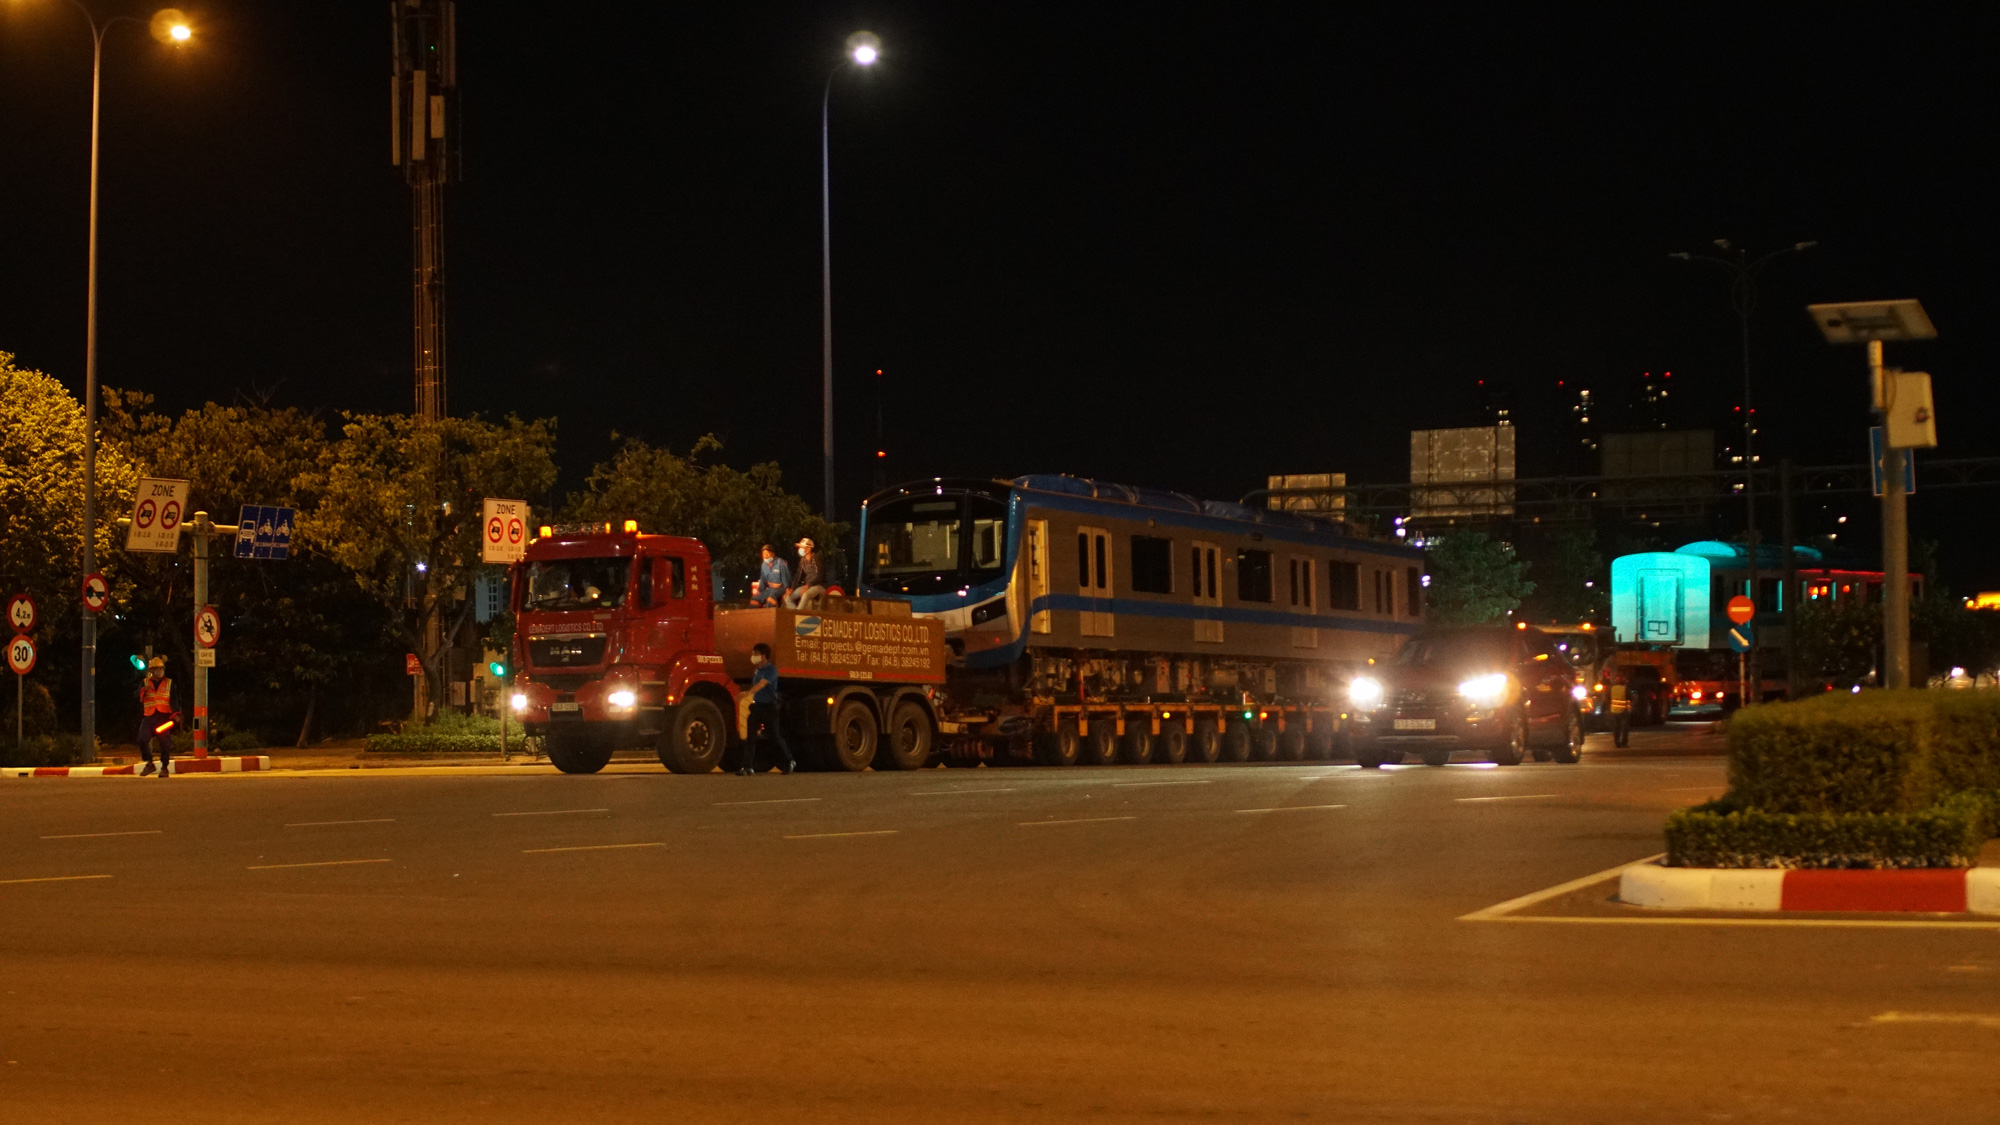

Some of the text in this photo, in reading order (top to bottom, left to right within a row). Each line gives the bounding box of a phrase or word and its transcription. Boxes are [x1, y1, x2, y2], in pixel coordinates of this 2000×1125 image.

[151, 484, 176, 497] ZONE
[496, 503, 516, 515] ZONE
[555, 622, 582, 633] LOGISTICS
[822, 619, 863, 638] GEMADEPT
[864, 621, 901, 641] LOGISTICS
[795, 636, 821, 649] Email:
[14, 646, 28, 662] 30
[796, 649, 809, 662] Tel:
